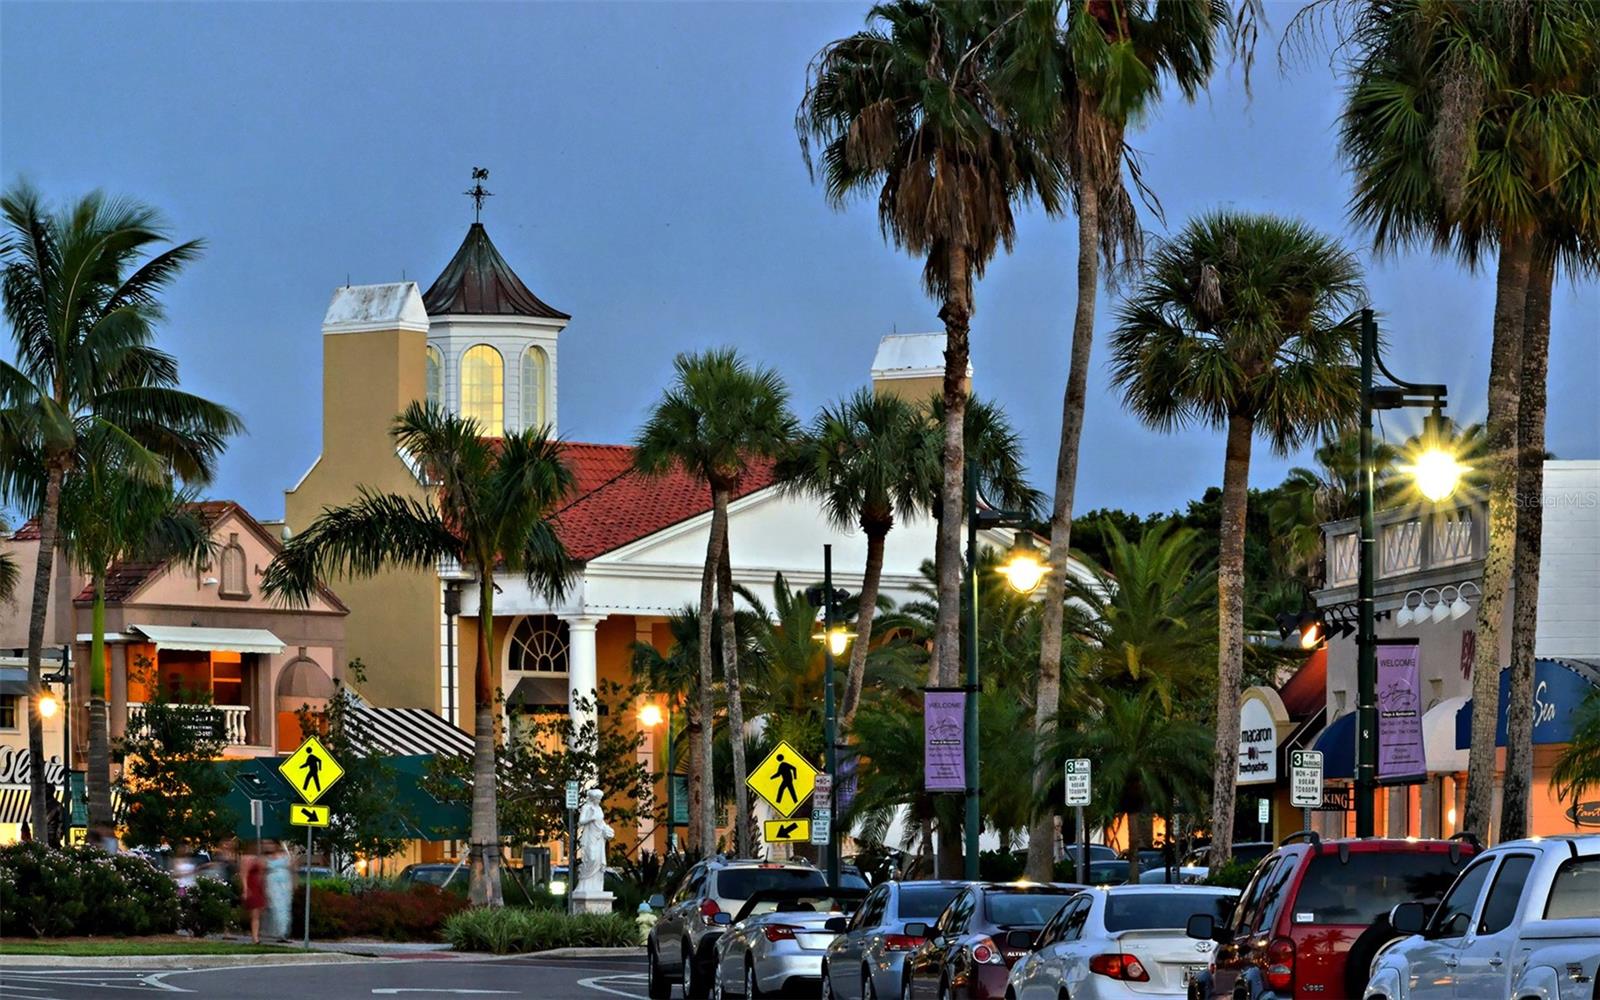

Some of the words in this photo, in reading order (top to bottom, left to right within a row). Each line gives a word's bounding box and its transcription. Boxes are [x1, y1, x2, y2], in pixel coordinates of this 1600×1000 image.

[1380, 658, 1416, 667] WELCOME
[1534, 680, 1556, 728] Sea
[1241, 727, 1272, 743] macaron
[1293, 753, 1302, 766] 3
[1067, 762, 1074, 773] 3
[1322, 792, 1348, 809] KING
